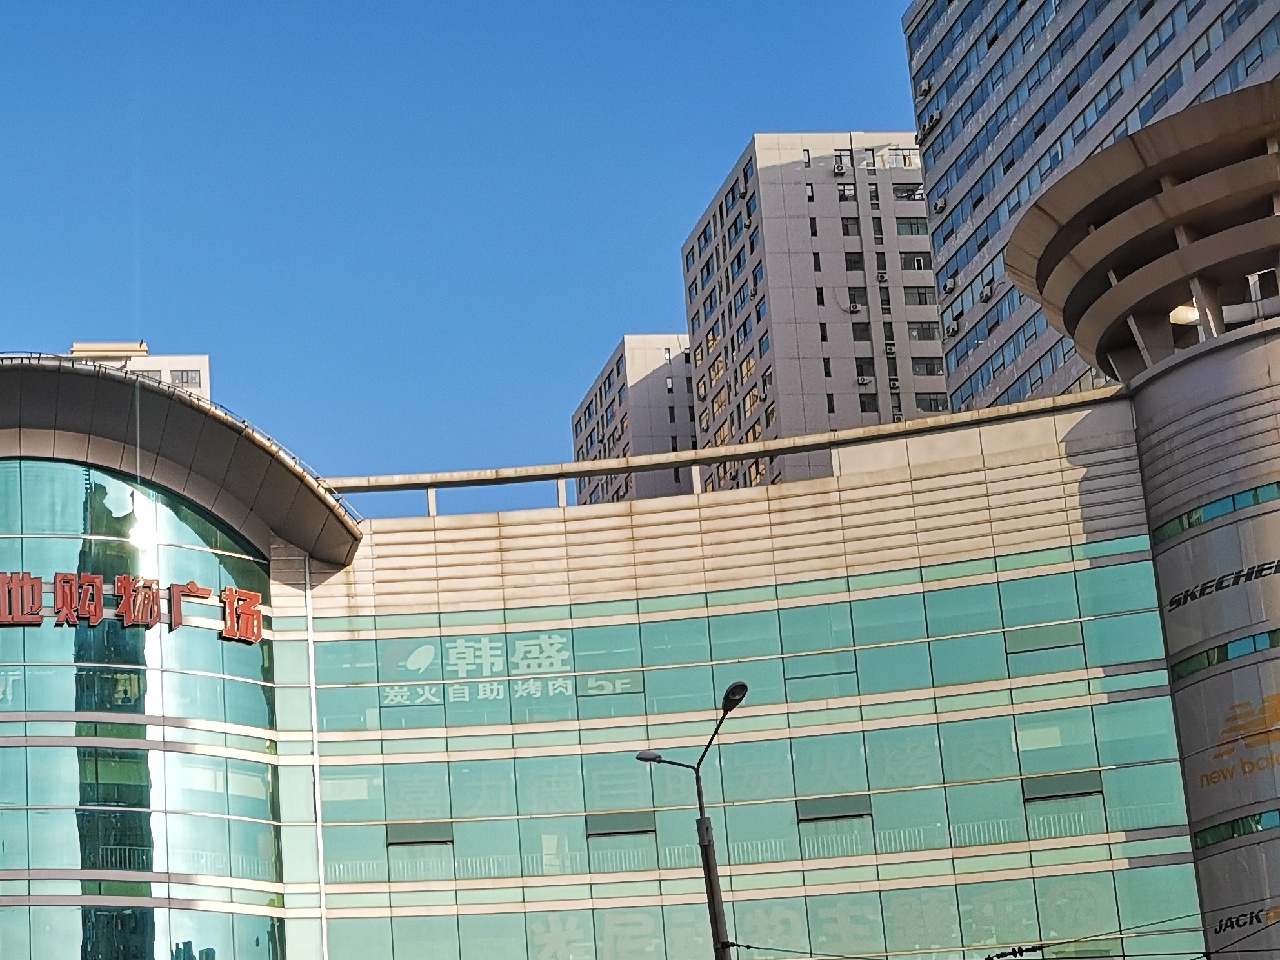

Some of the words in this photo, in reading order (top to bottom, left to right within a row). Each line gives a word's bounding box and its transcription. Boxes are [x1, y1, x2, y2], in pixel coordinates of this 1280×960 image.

[1168, 559, 1280, 612] SKECHE
[445, 634, 571, 678] 韩盛
[383, 678, 574, 705] 炭火自助烤肉
[1199, 764, 1236, 788] new
[1214, 908, 1264, 935] JACK
